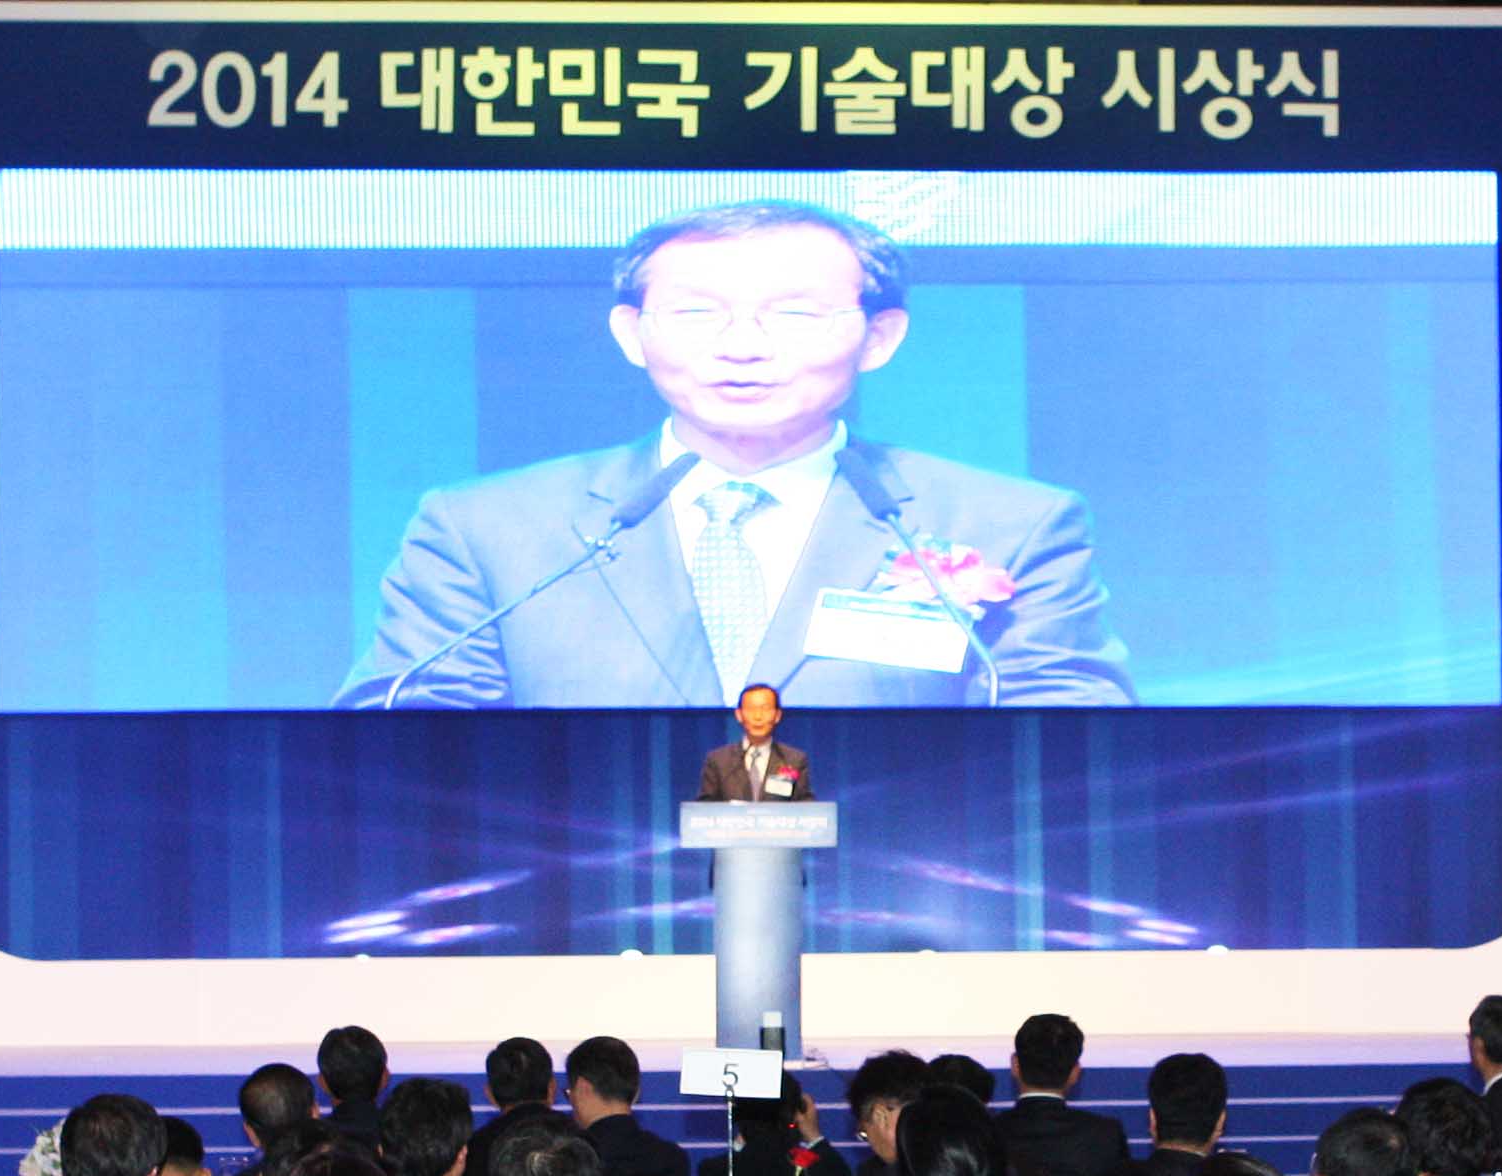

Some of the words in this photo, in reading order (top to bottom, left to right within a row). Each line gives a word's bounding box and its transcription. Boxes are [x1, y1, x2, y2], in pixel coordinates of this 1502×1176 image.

[147, 48, 349, 129] 2014
[379, 45, 711, 138] 대한민국
[743, 45, 1076, 139] 기술대상
[1100, 46, 1340, 140] 시상식
[721, 1062, 740, 1090] 5
